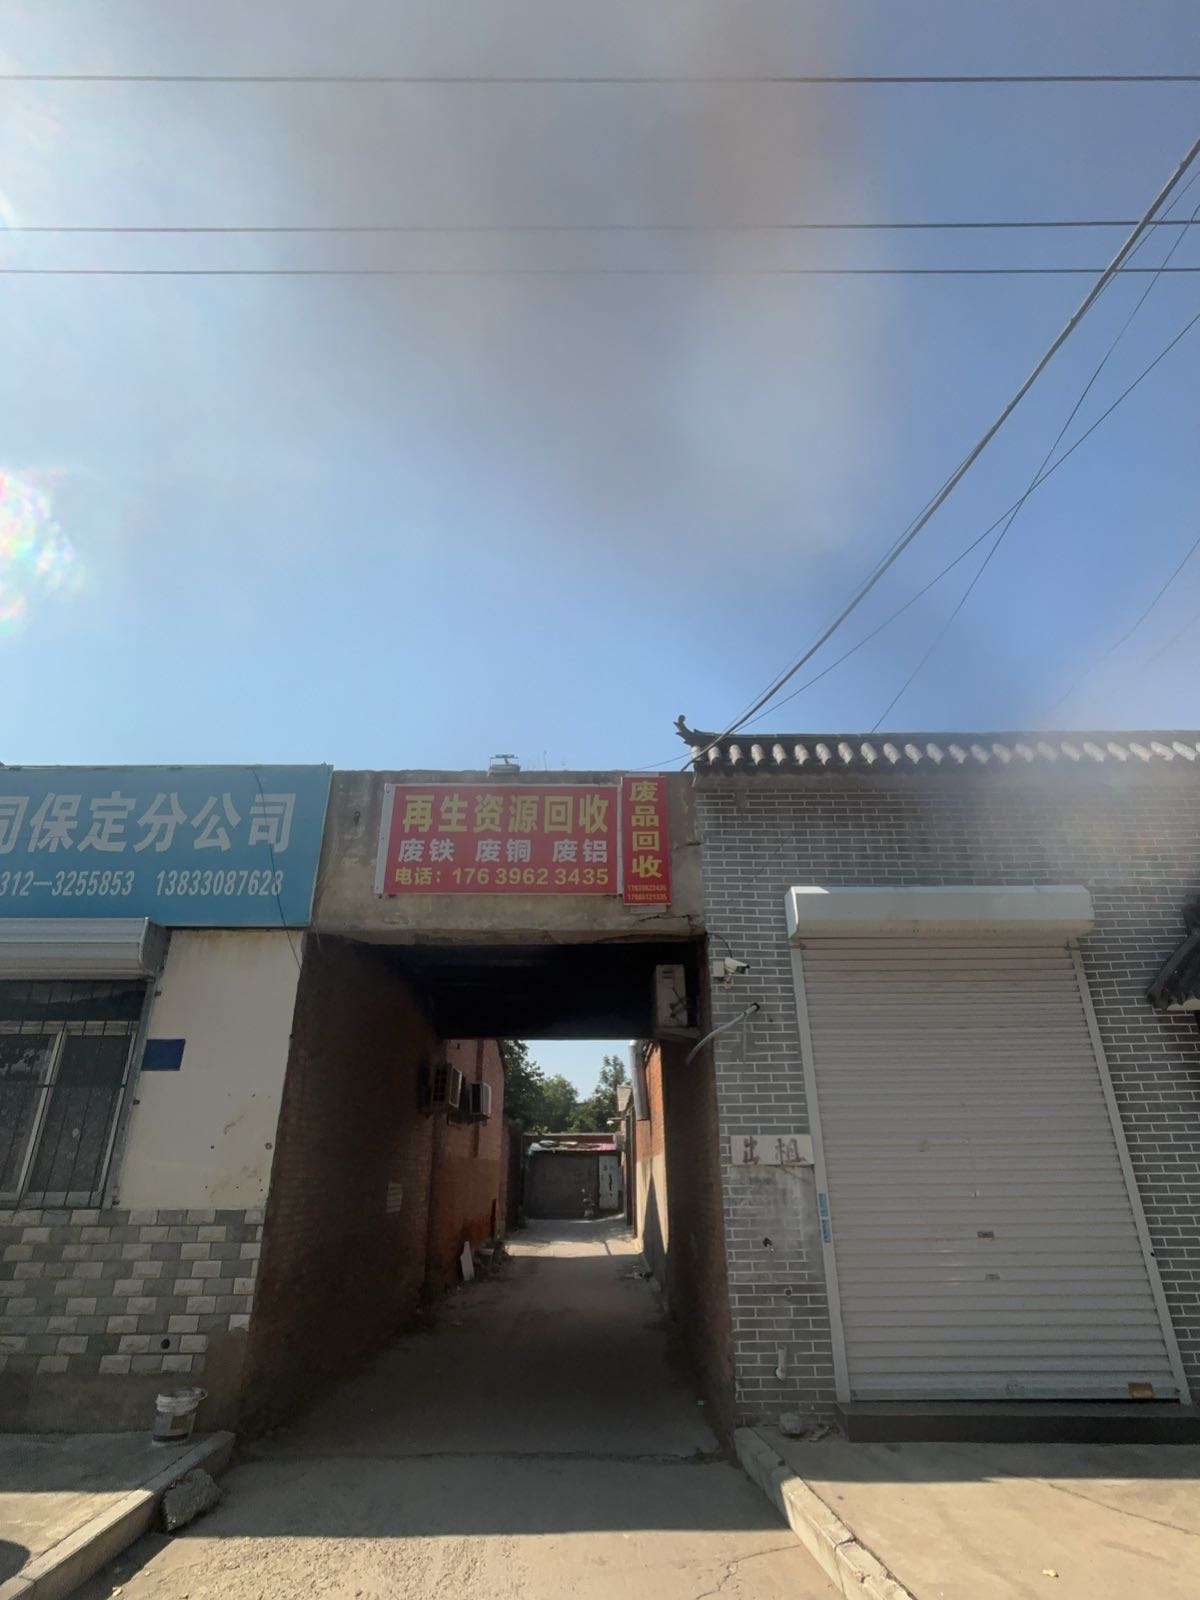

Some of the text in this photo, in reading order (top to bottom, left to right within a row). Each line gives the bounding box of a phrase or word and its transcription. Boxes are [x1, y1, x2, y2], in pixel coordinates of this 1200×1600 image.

[403, 793, 609, 833] 再生资源回收
[629, 781, 662, 878] 废品回收
[398, 838, 608, 863] 废铁 废铜 废铝
[156, 870, 283, 896] 13833087628
